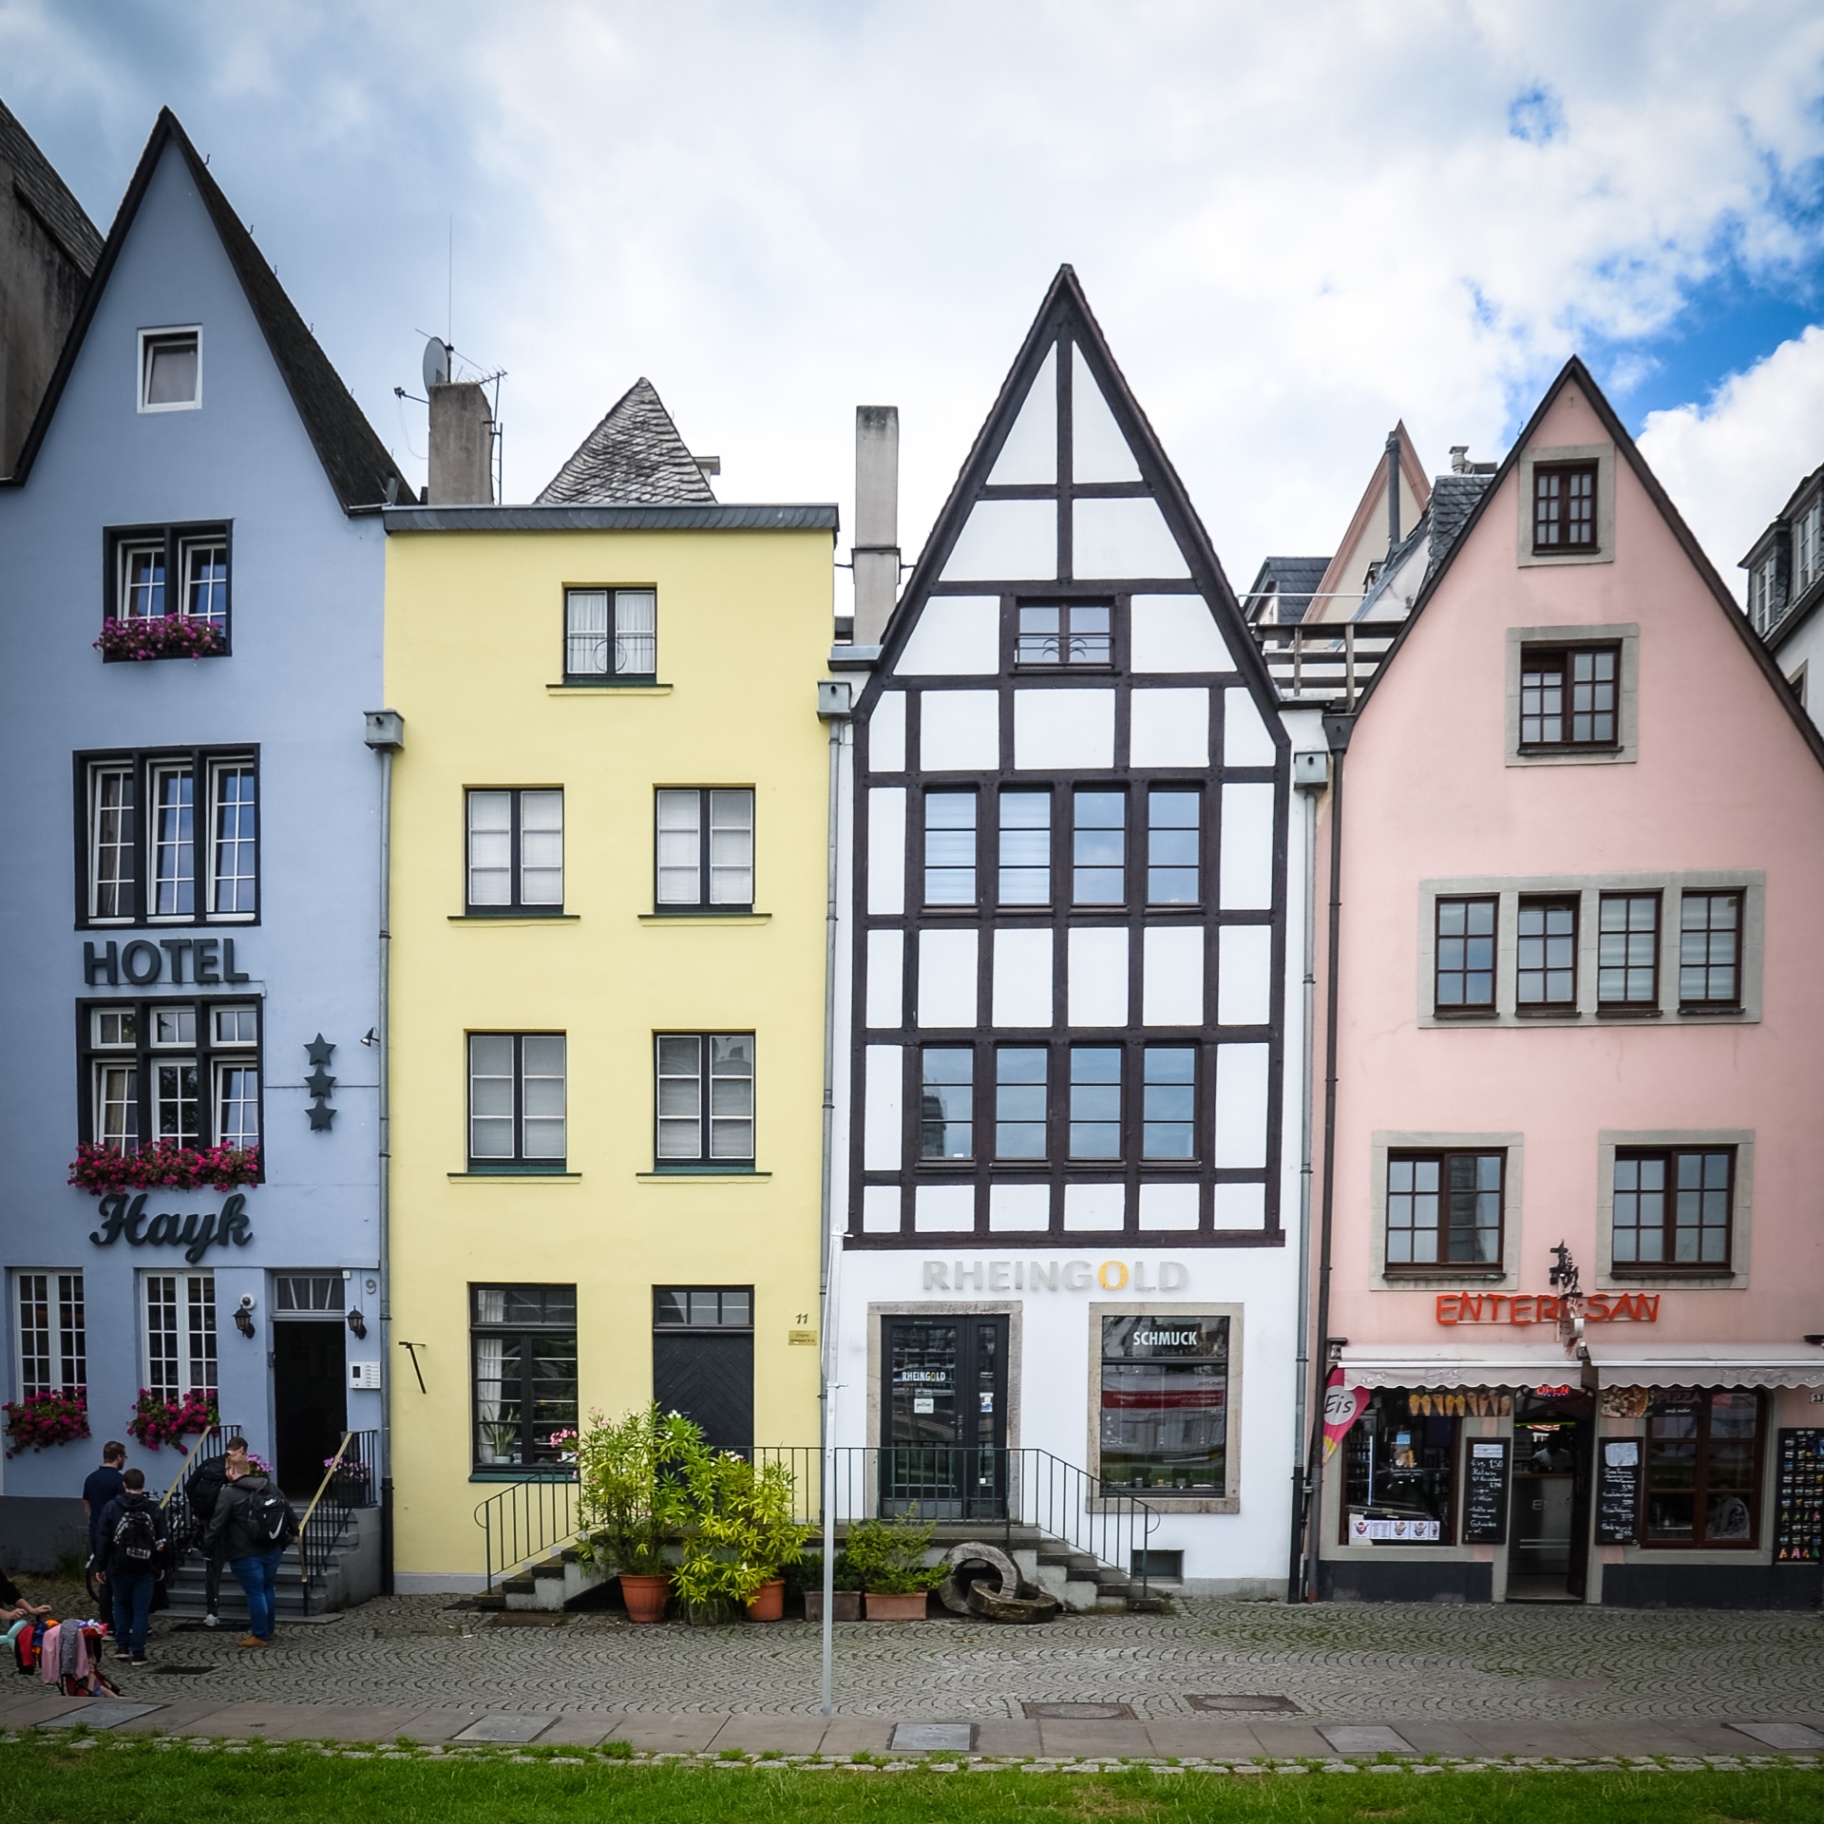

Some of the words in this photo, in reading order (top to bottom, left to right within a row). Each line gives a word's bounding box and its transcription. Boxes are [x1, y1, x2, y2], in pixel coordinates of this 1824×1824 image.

[83, 938, 249, 985] HOTEL
[89, 1193, 253, 1264] Hayk
[922, 1260, 1189, 1291] RHEINGOLD
[365, 1279, 377, 1295] 9
[1436, 1291, 1660, 1326] ENTERSAN
[795, 1313, 809, 1324] 11
[1133, 1331, 1198, 1346] SCHMUCK
[901, 1371, 946, 1382] RHEINGOLD
[1536, 1385, 1569, 1395] OPEN
[1656, 1391, 1702, 1403] PIZZA
[1325, 1394, 1353, 1414] Eis
